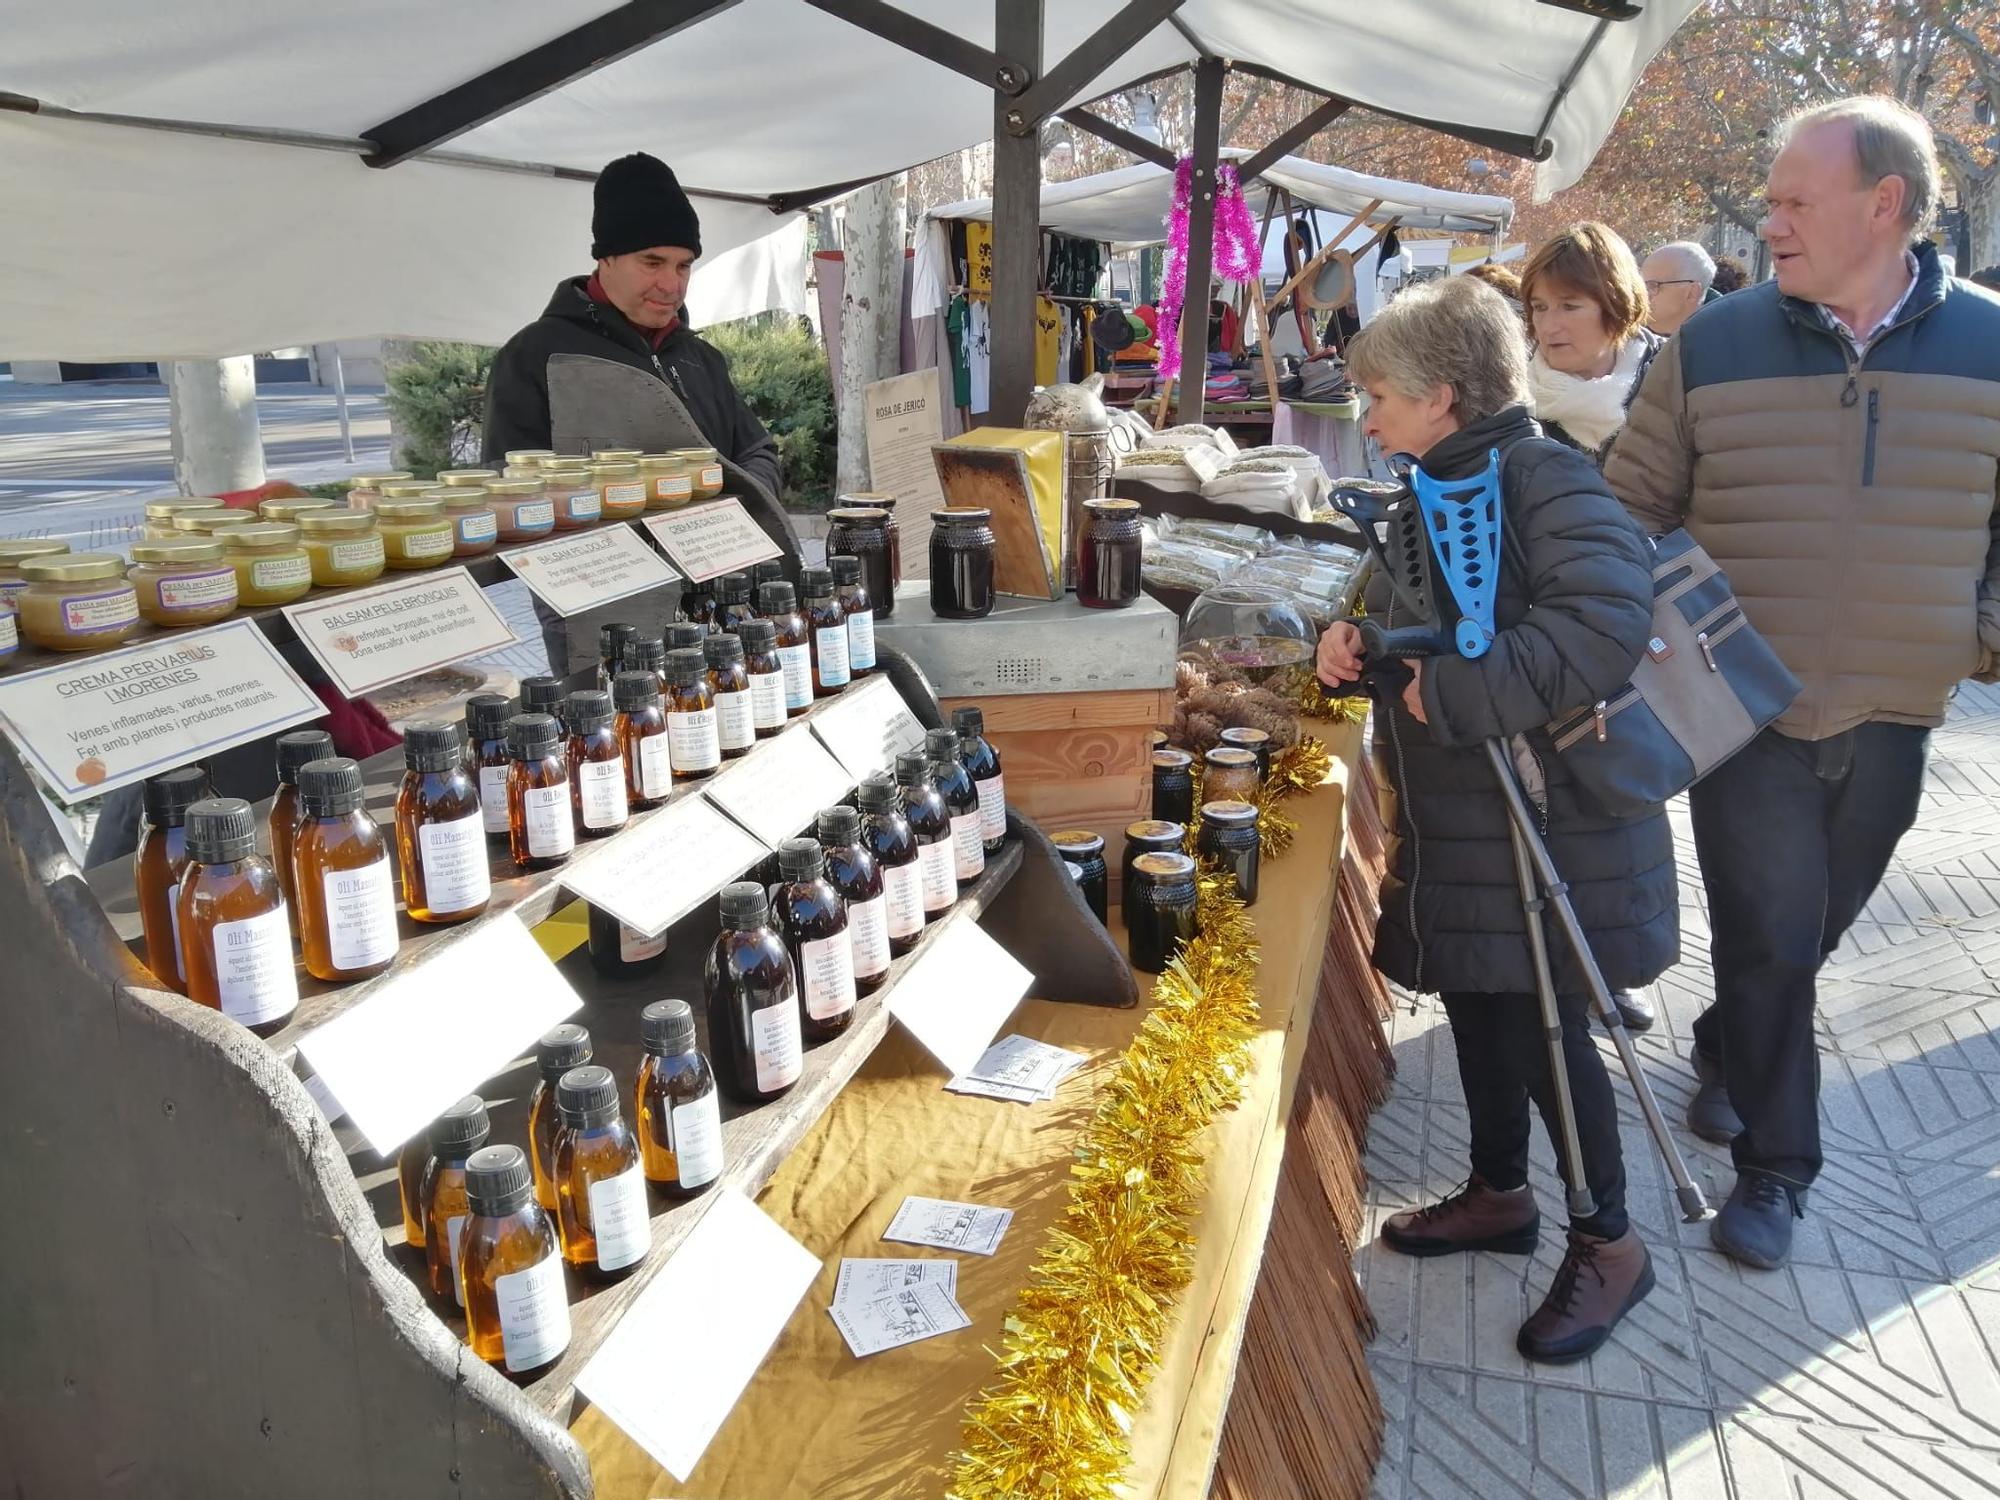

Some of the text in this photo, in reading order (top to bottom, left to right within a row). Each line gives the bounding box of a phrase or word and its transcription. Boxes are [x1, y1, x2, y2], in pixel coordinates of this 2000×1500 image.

[875, 405, 892, 419] ROSA
[893, 402, 903, 414] DE
[322, 586, 460, 630] BALSAM PELS BRONQUIS
[339, 635, 356, 648] Per
[350, 645, 374, 659] Dona
[56, 644, 216, 697] CREMA PER VARIUS
[114, 667, 200, 700] MORENES
[67, 722, 111, 744] Venes
[111, 704, 179, 731] inflamades,
[180, 691, 217, 712] varius,
[76, 743, 103, 760] Fet
[103, 735, 131, 752] amb
[131, 722, 175, 747] plantes
[181, 704, 235, 731] productes
[227, 931, 242, 946] Oli
